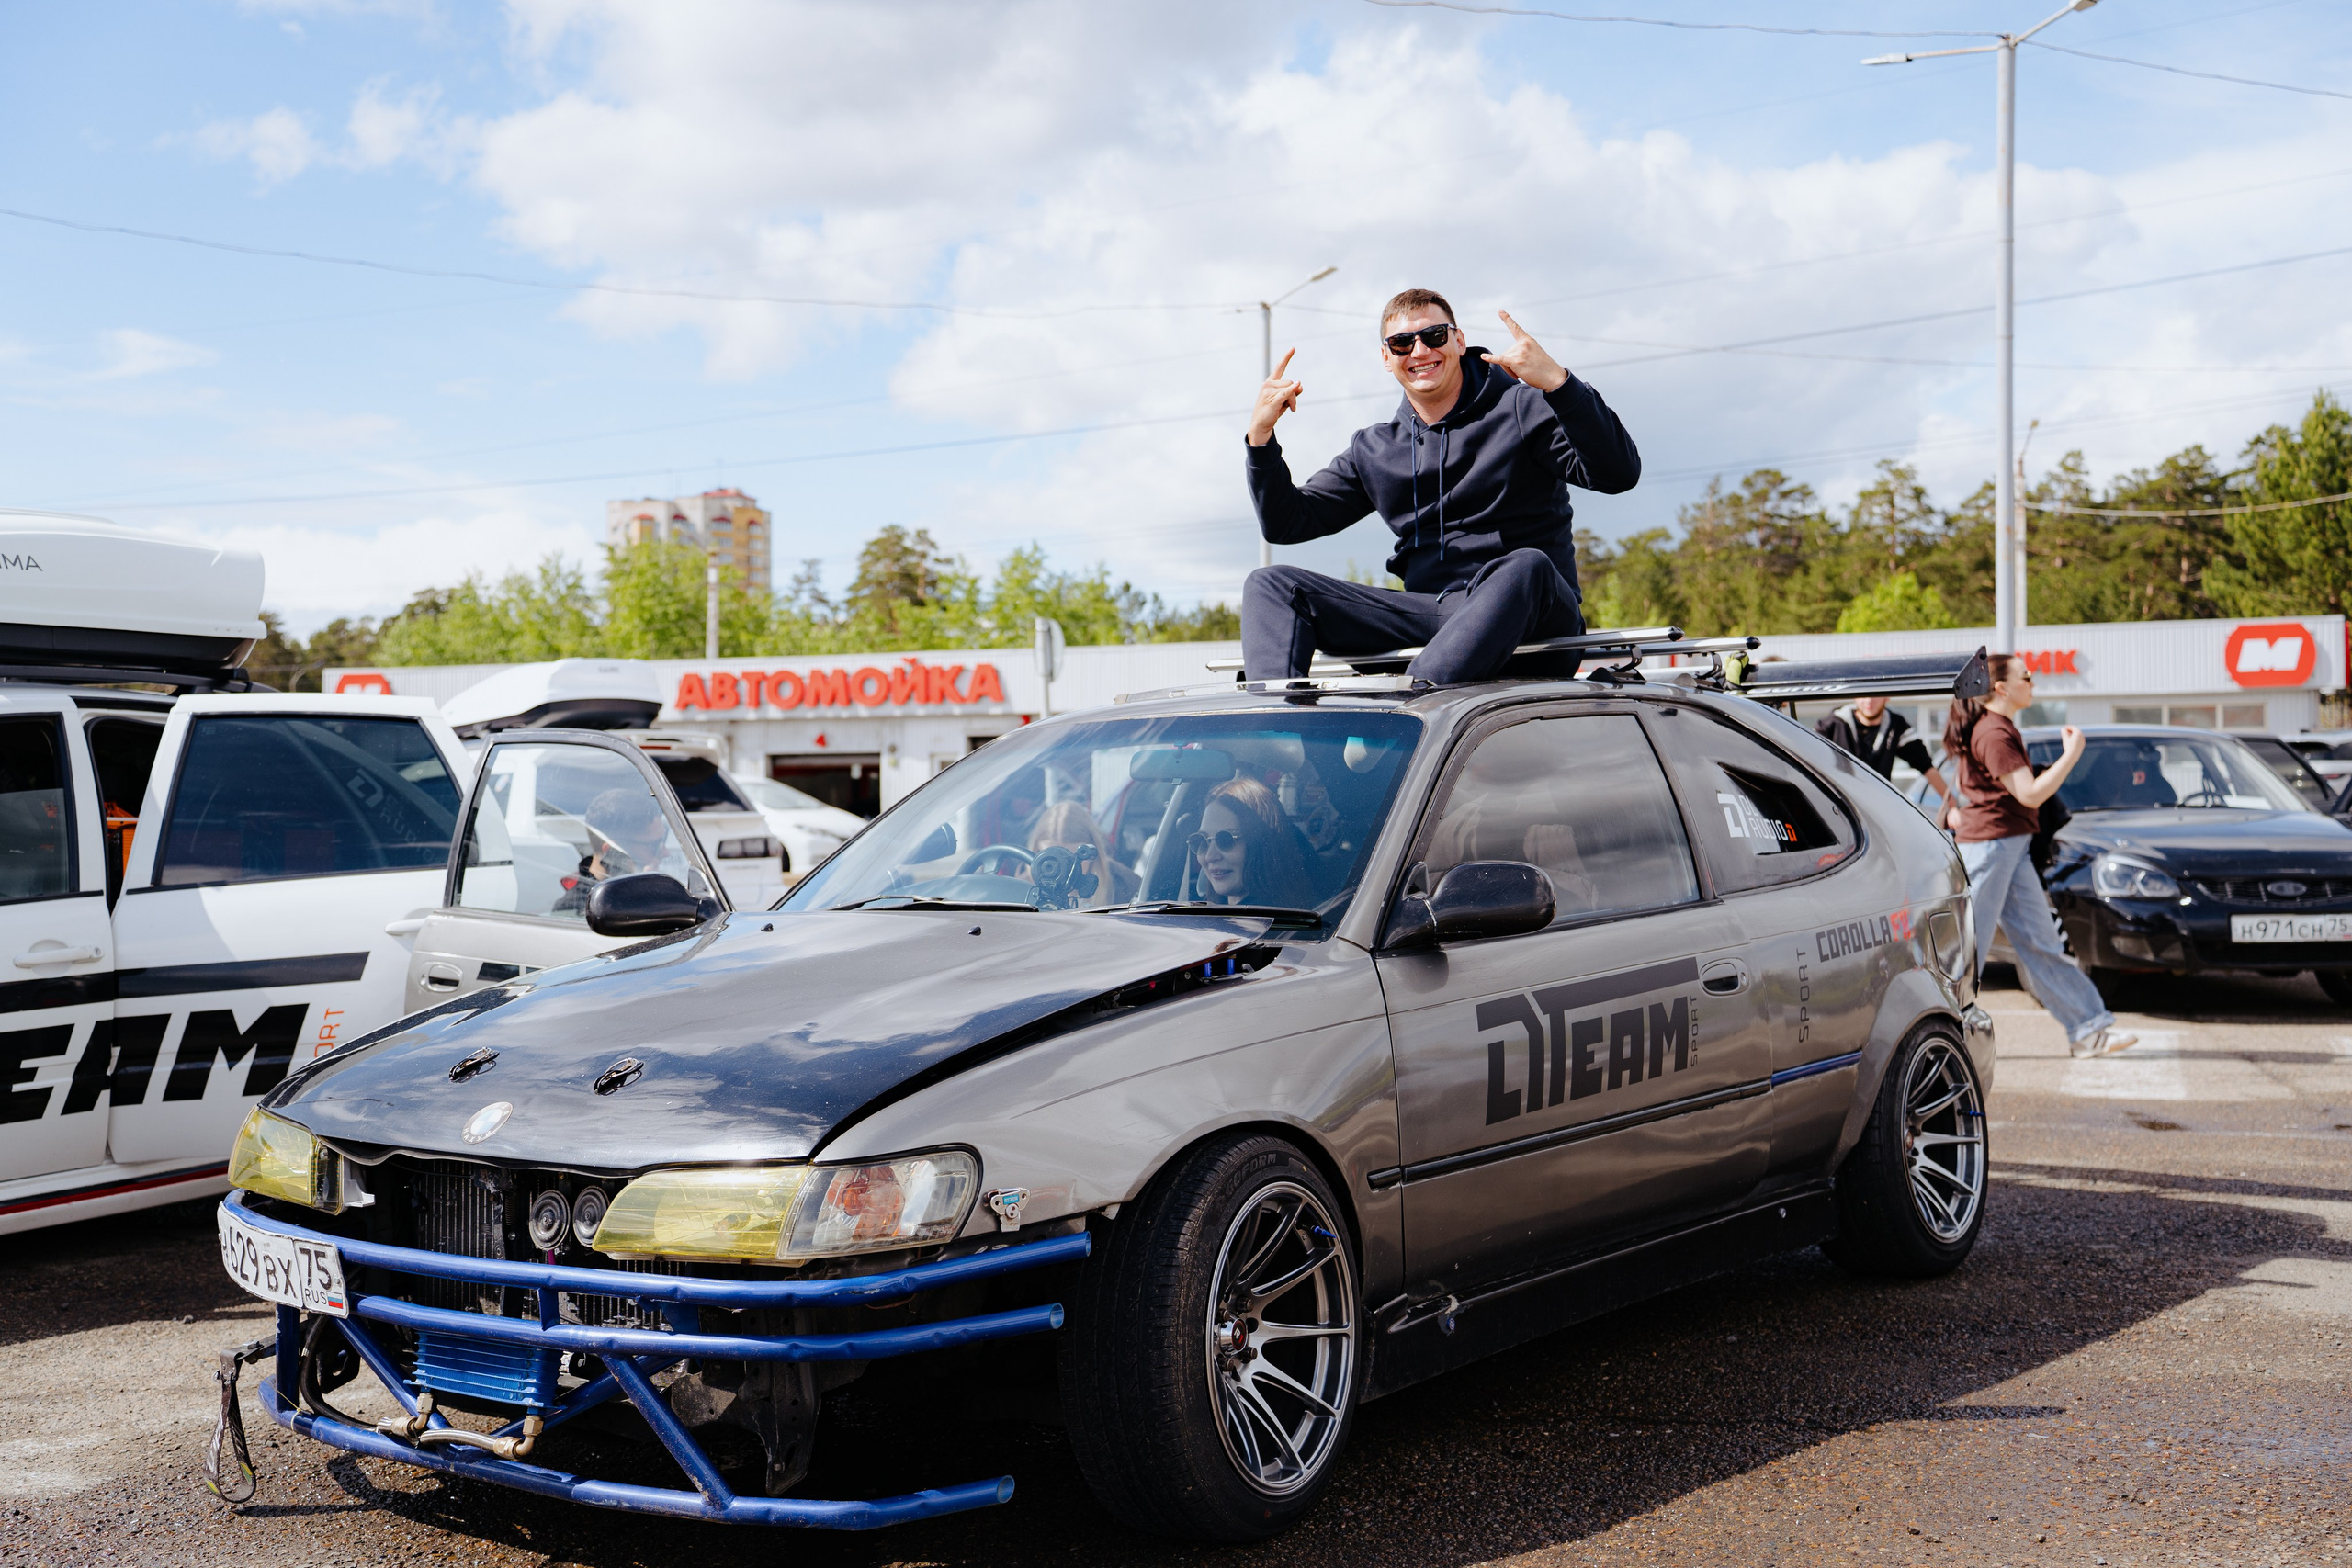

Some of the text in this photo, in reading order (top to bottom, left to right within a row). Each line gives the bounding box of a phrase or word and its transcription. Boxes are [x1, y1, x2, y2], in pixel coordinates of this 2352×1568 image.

[0, 553, 43, 571] MA
[2015, 649, 2079, 675] ИК
[675, 658, 1005, 711] АВТОМОЙКА
[814, 733, 827, 748] 4
[2242, 919, 2347, 938] Н971СН 75
[1796, 947, 1810, 1043] SPORT
[1690, 995, 1699, 1067] SPORT
[299, 1247, 332, 1290] 75
[304, 1288, 327, 1304] RUS
